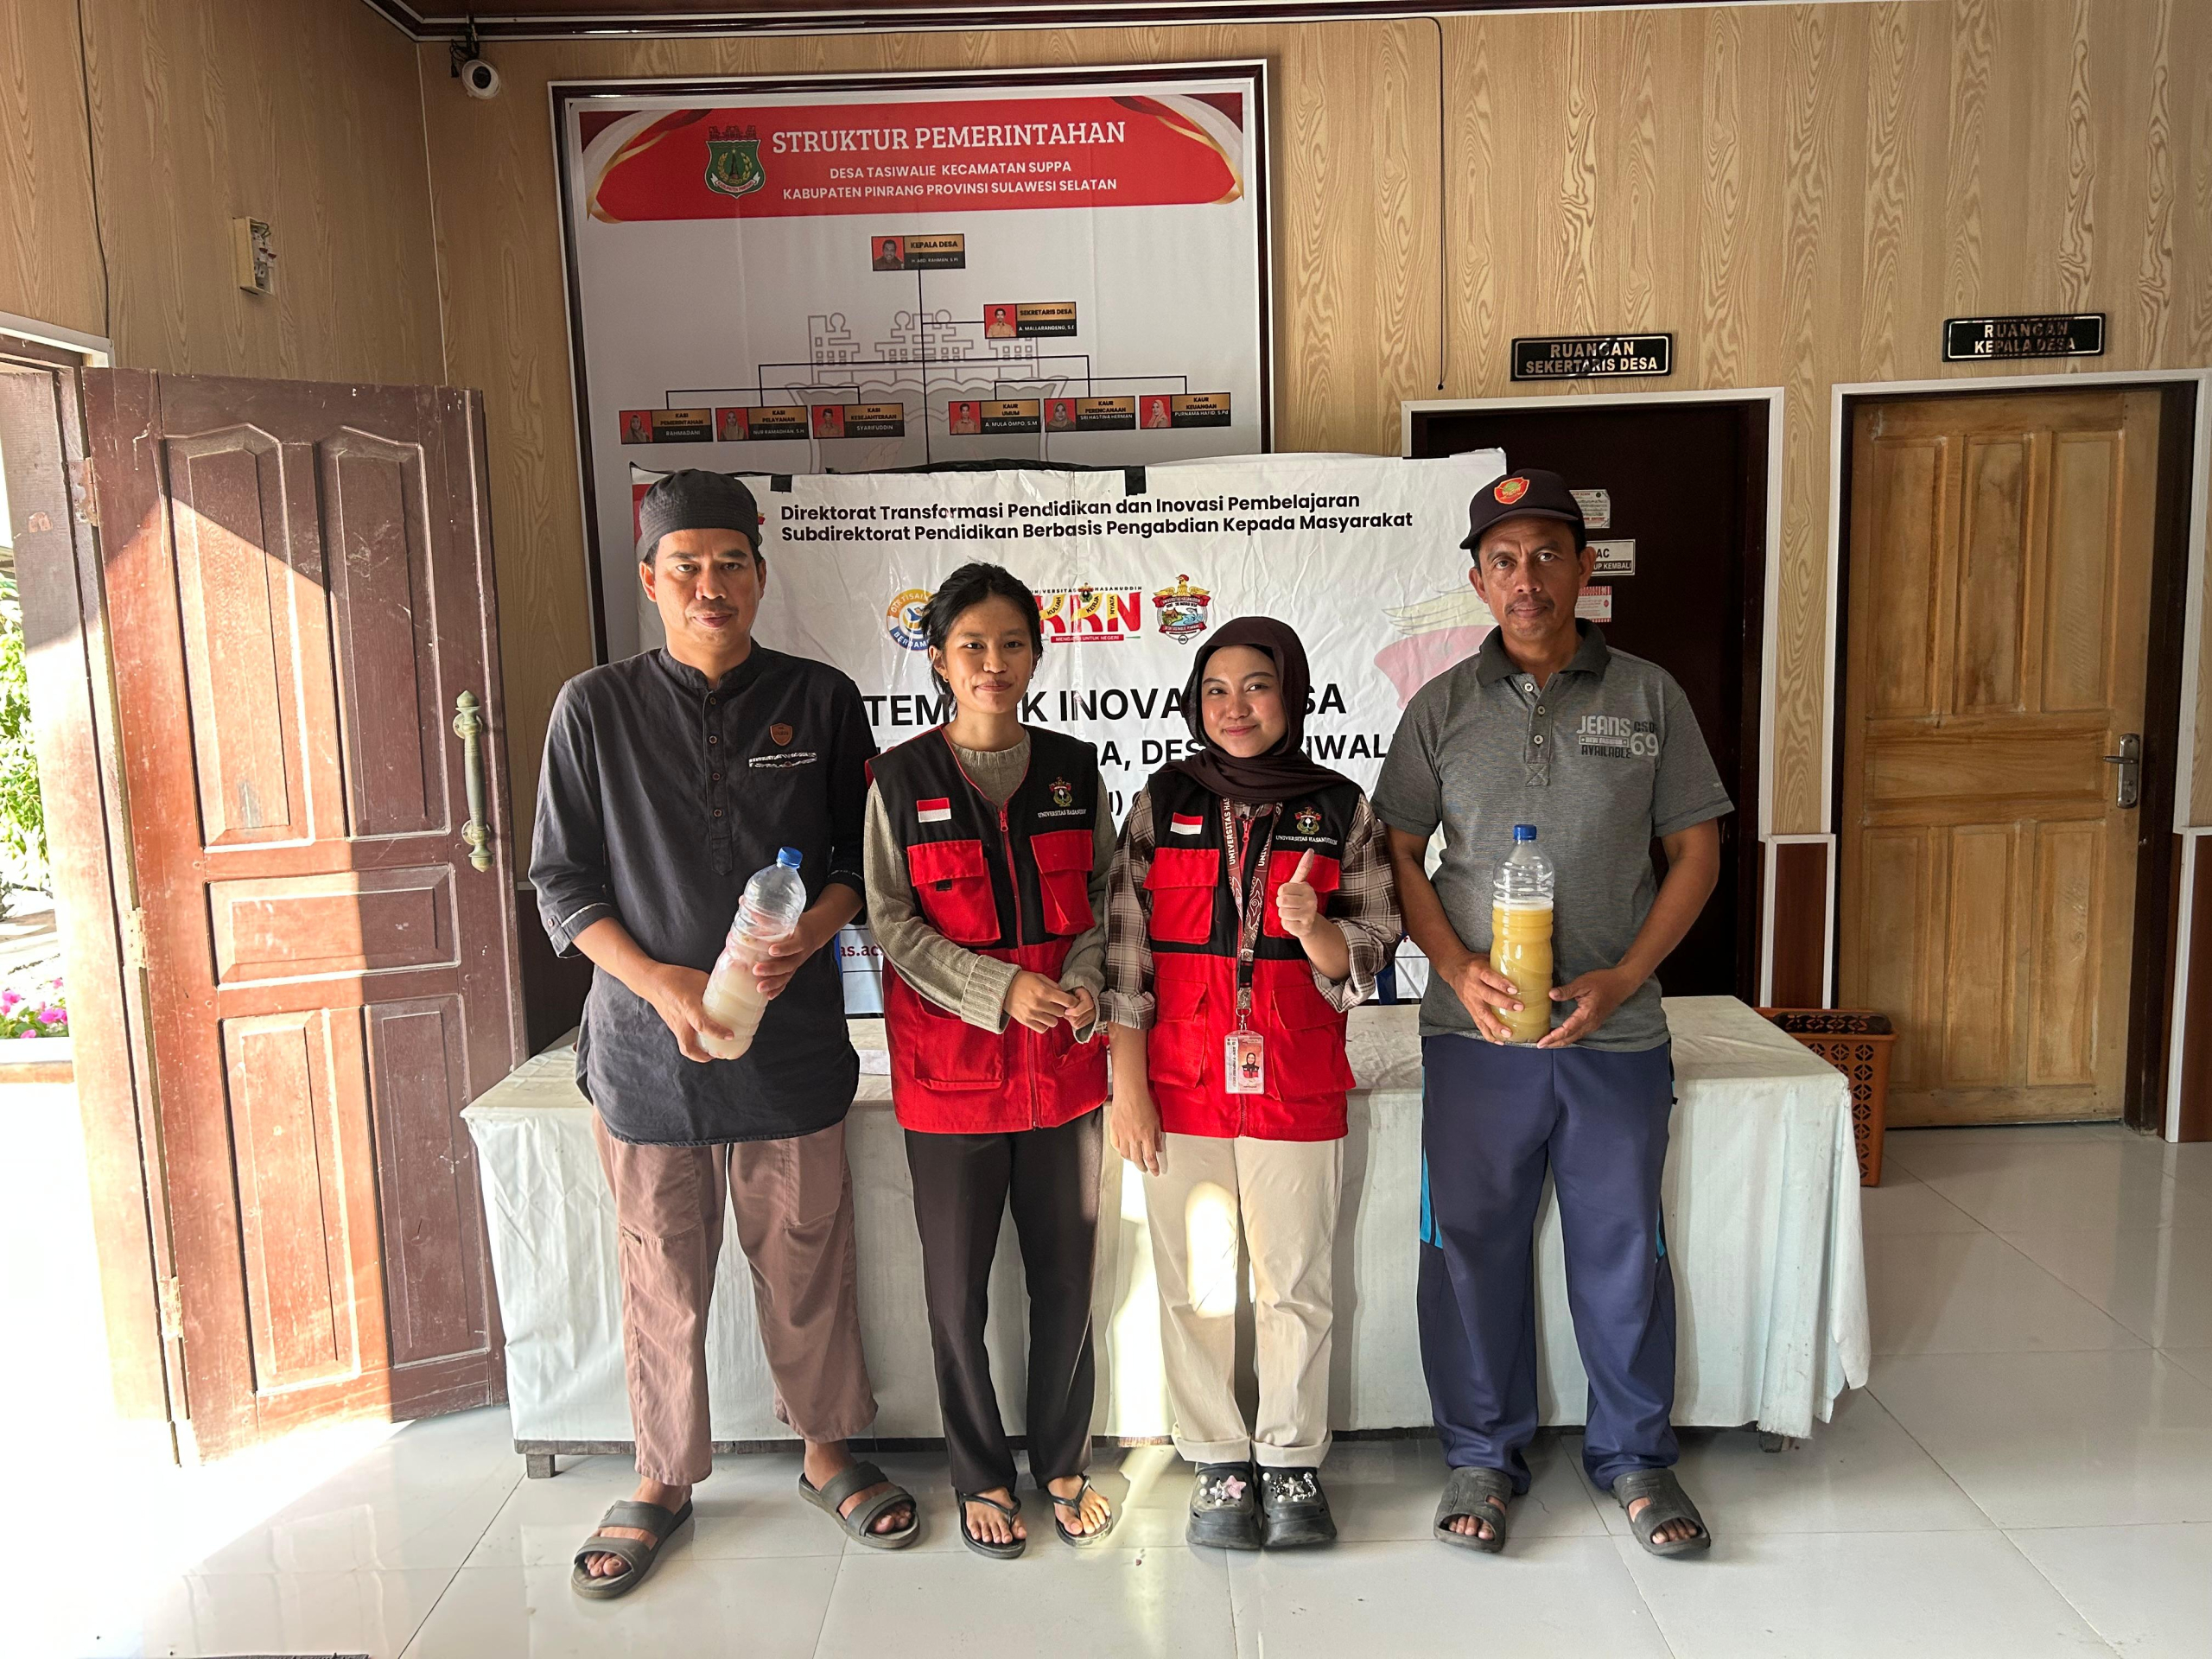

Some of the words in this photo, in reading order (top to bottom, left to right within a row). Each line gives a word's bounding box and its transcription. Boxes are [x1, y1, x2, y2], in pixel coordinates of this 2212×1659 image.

[772, 128, 909, 154] STRUKTUR
[915, 121, 1126, 149] PEMERINTAHAN
[830, 168, 864, 179] DESA
[867, 165, 936, 178] TASIWALIE
[942, 162, 1026, 175] KECAMATAN
[1028, 161, 1071, 173] SUPPA
[783, 187, 861, 200] KABUPATEN
[865, 185, 924, 197] PINRANG
[927, 182, 988, 195] PROVINSI
[991, 180, 1057, 194] SULAWESI
[1059, 179, 1117, 191] SELATAN
[1984, 321, 2068, 338] RUANGAN
[1550, 341, 1634, 359] RUANGAN
[1974, 338, 2031, 353] KEPALA
[2037, 337, 2075, 352] DESA
[1526, 358, 1615, 374] SEKERTARIS
[1619, 357, 1658, 370] DESA
[781, 505, 876, 520] Direktorat
[880, 502, 1003, 520] Transformasi
[1007, 500, 1111, 518] Pendidikan
[1116, 499, 1152, 513] dan
[1156, 495, 1224, 513] Inovasi
[1228, 492, 1360, 513] Pembelajaran
[782, 525, 910, 541] Subdirektorat
[915, 524, 1019, 541] Pendidikan
[1023, 519, 1102, 537] Berbasis
[1107, 517, 1218, 539] Pengabdian
[1224, 515, 1295, 536] Kepada
[1300, 512, 1413, 533] Masyarakat
[1046, 596, 1062, 615] KULIAH
[1085, 595, 1099, 613] KERJA
[1060, 688, 1185, 721] INOVA
[1576, 715, 1631, 737] JEANS
[1630, 732, 1659, 757] 69
[1224, 811, 1236, 866] UNIVERSITAS
